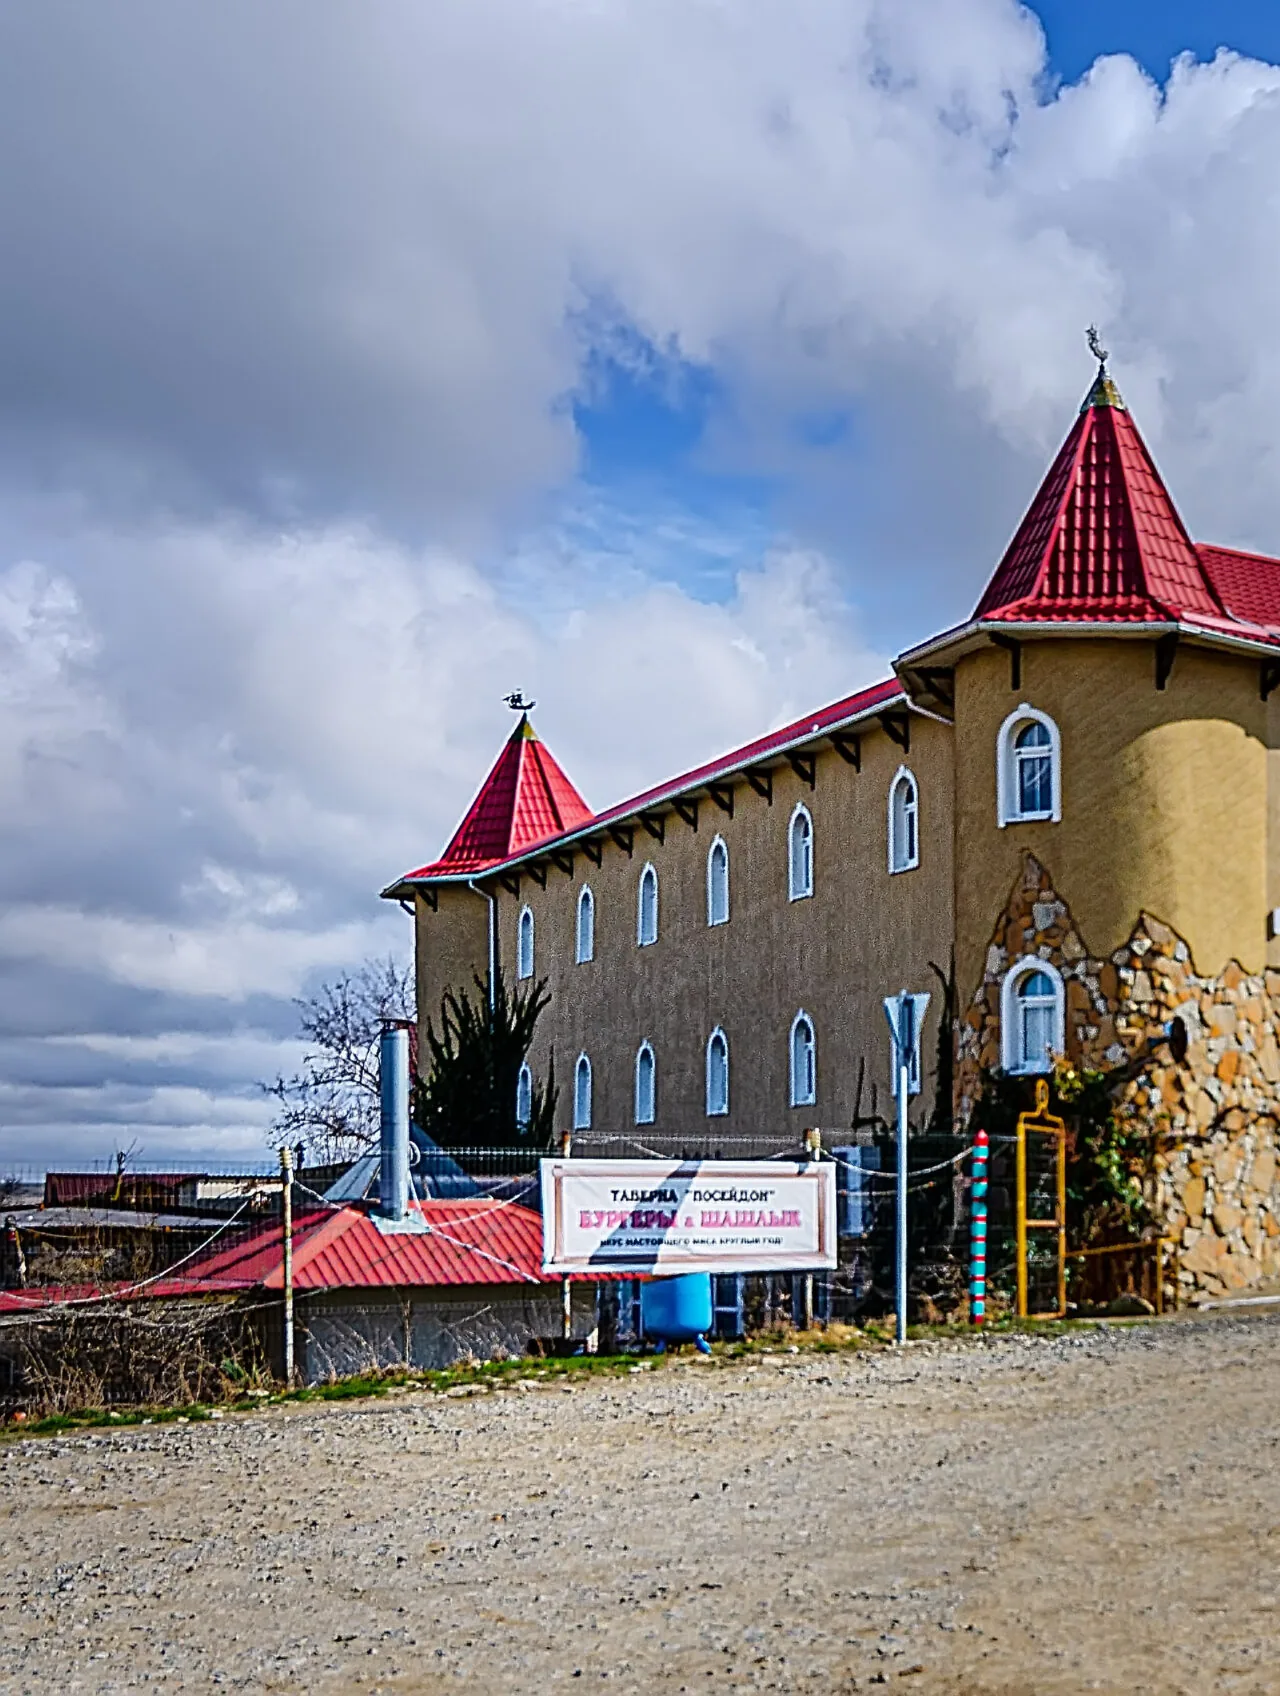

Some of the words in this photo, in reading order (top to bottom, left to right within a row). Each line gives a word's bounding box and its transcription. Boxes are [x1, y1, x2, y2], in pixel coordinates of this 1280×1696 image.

[611, 1189, 678, 1203] ТАВЕРНА
[579, 1209, 678, 1229] БУРГЕРЫ
[701, 1210, 801, 1228] ШАШЛЫК
